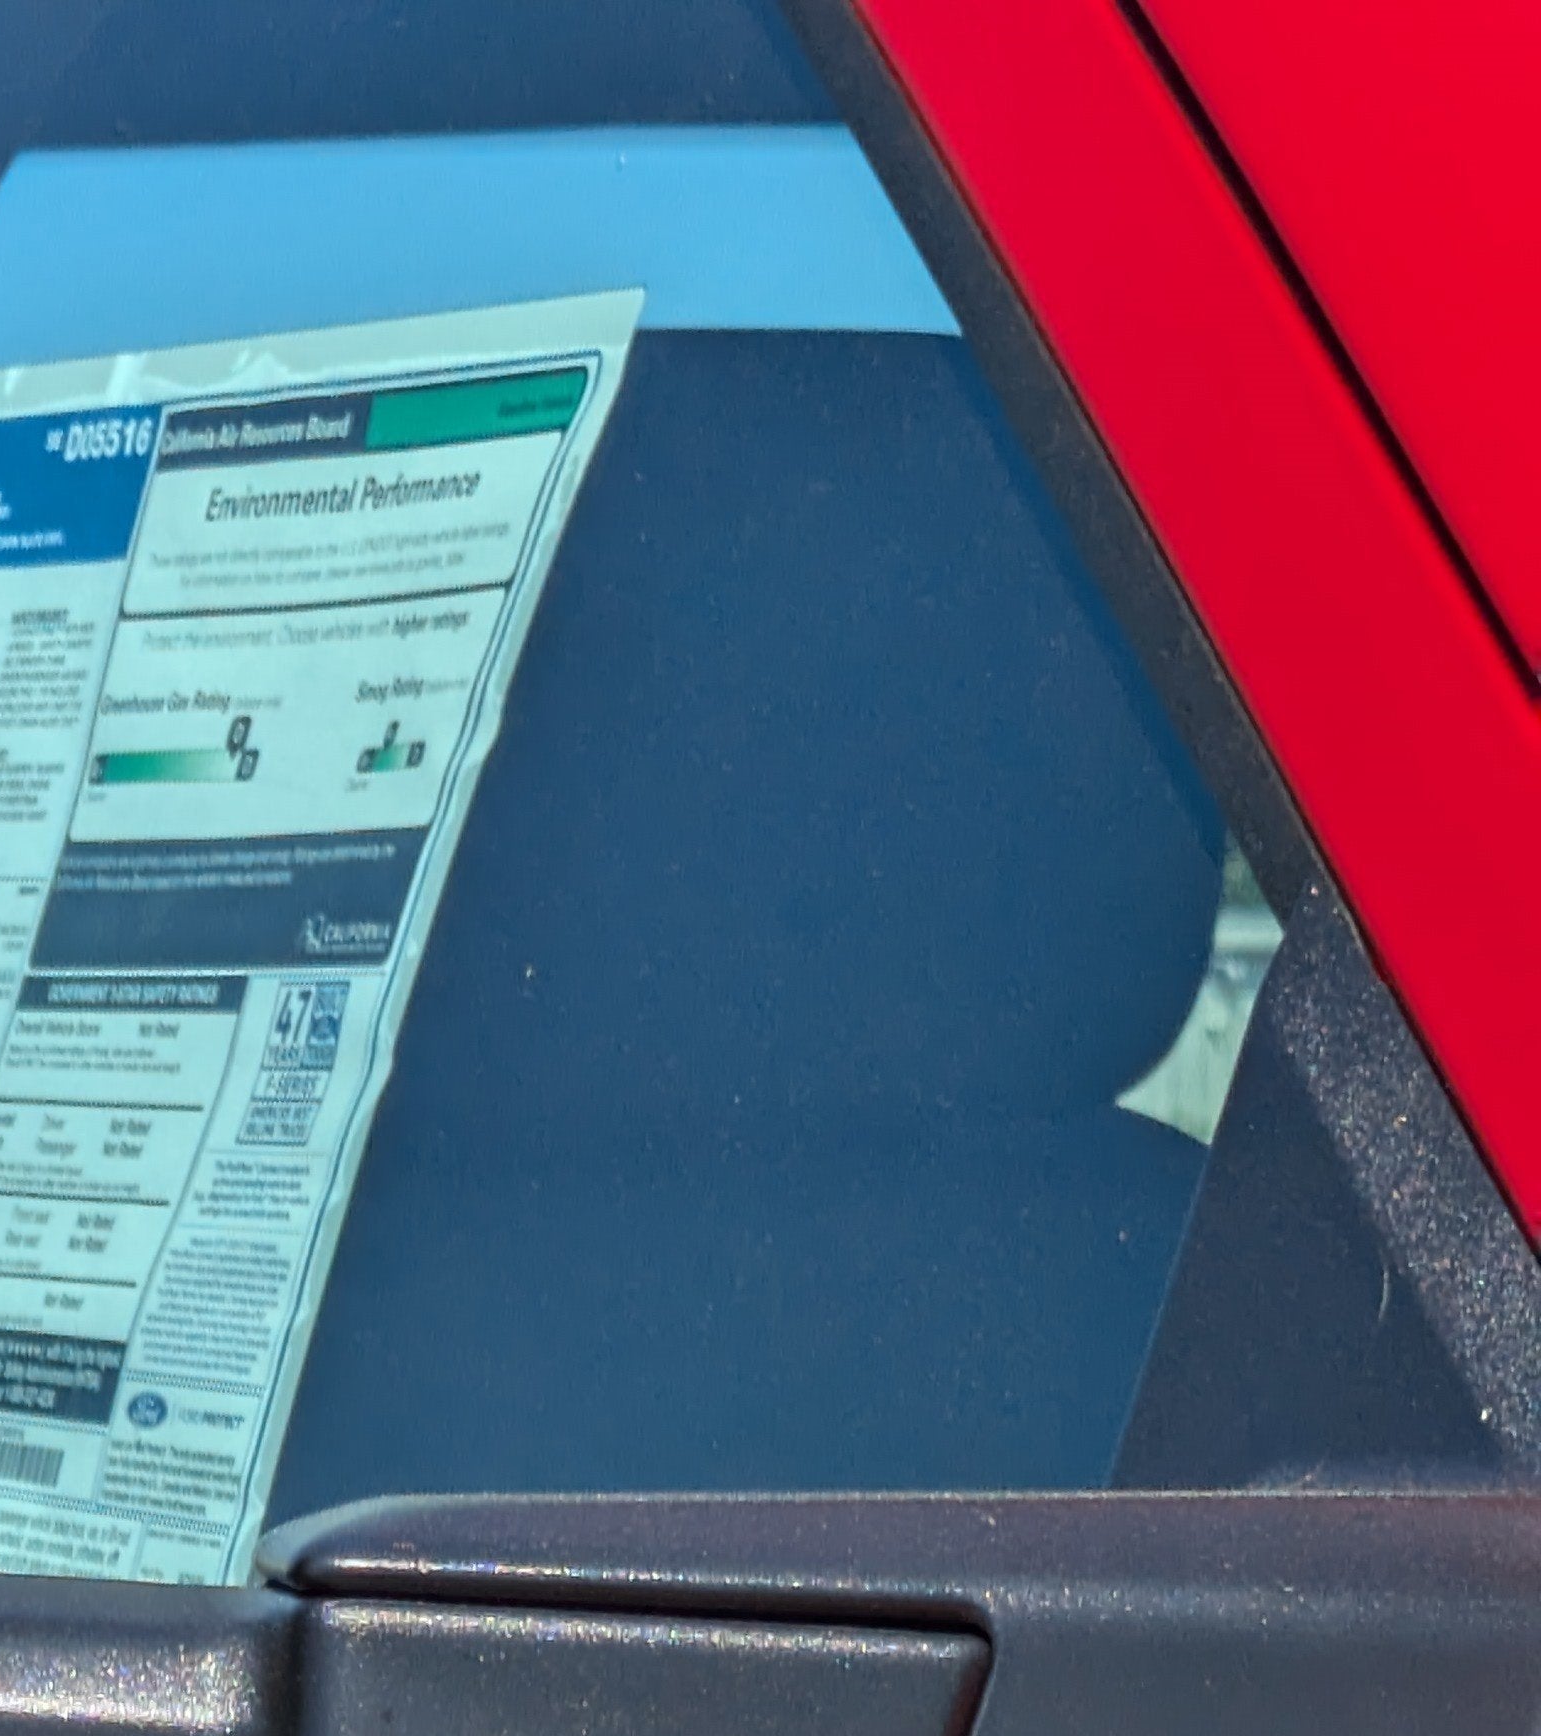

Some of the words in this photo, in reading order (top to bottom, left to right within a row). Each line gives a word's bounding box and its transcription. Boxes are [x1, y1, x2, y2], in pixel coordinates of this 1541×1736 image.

[217, 423, 239, 448] Air
[240, 419, 305, 448] Resources
[306, 411, 353, 441] Board
[204, 477, 357, 521] Environmental
[360, 470, 482, 511] Performance
[166, 691, 191, 713] Gas
[192, 688, 231, 714] Rating
[354, 681, 391, 704] Smog
[392, 676, 425, 699] Rating
[274, 988, 313, 1045] 47
